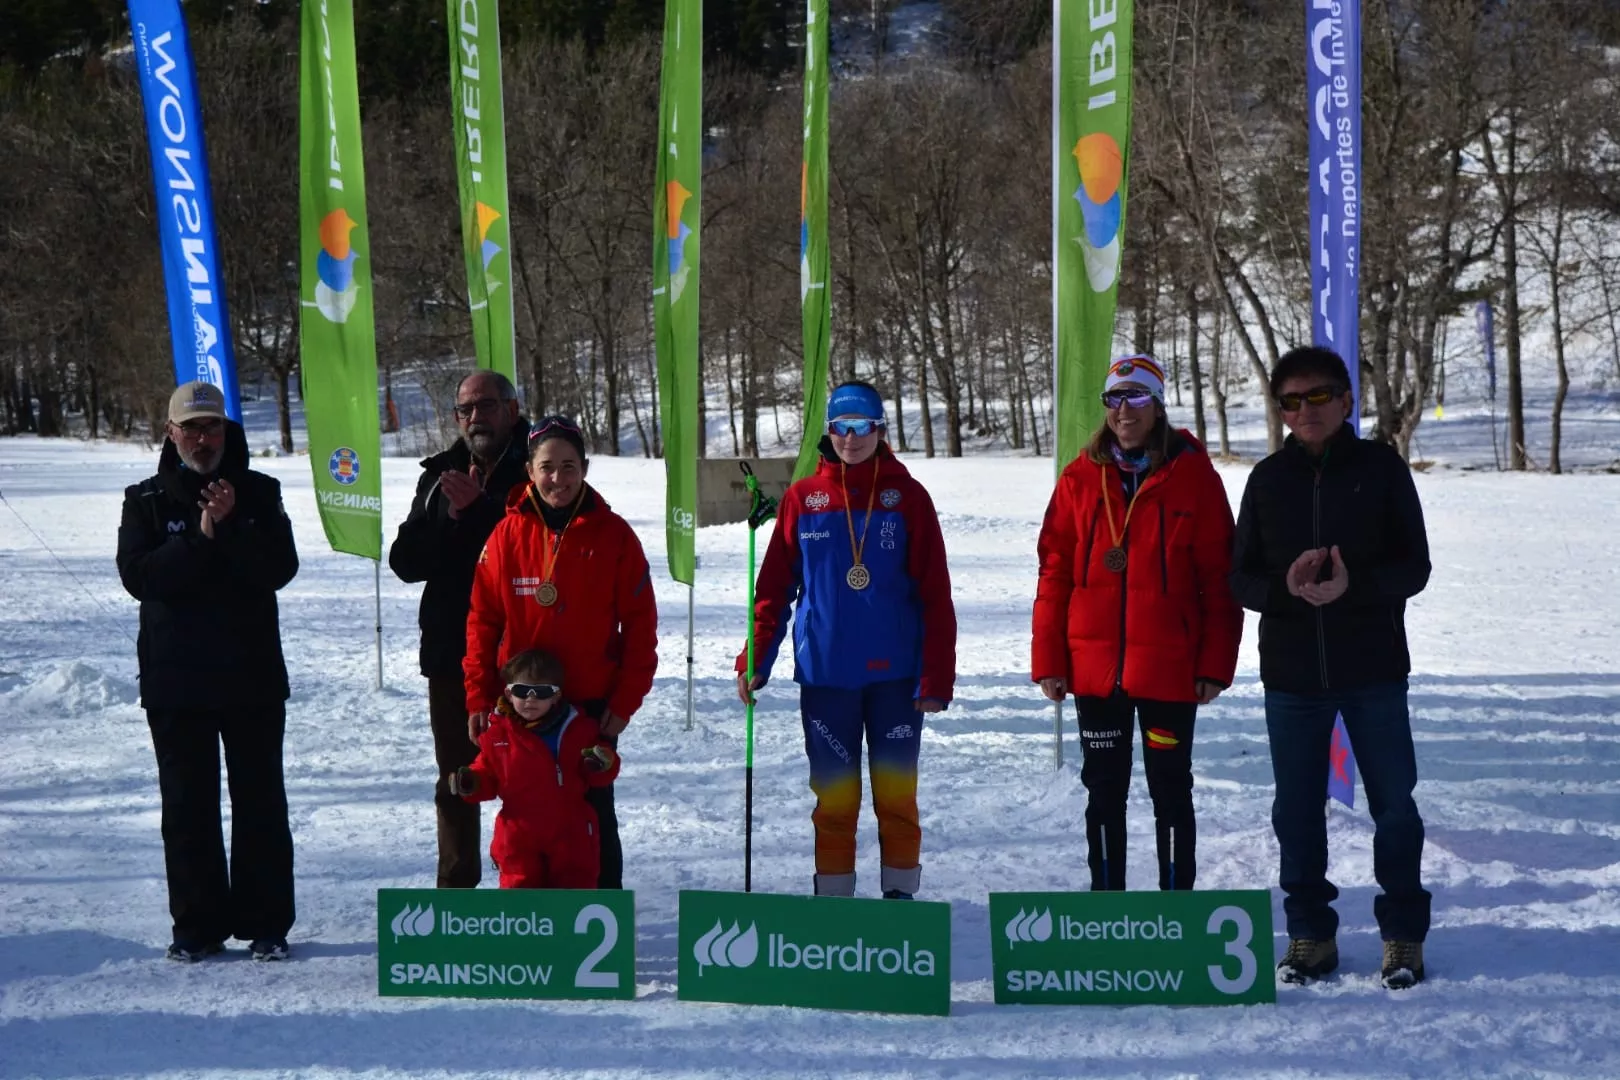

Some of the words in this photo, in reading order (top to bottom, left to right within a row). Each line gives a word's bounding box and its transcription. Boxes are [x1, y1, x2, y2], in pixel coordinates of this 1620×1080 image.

[1332, 75, 1349, 108] de
[1082, 728, 1122, 738] GUARDIA
[1090, 740, 1116, 749] CIVIL
[441, 911, 554, 936] Iberdrola
[1059, 914, 1182, 940] Iberdrola
[574, 903, 619, 988] 2
[768, 933, 935, 976] Iberdrola
[1206, 905, 1257, 995] 3
[390, 963, 553, 985] SPAINSNOW
[1006, 969, 1184, 992] SPAINSNOW
